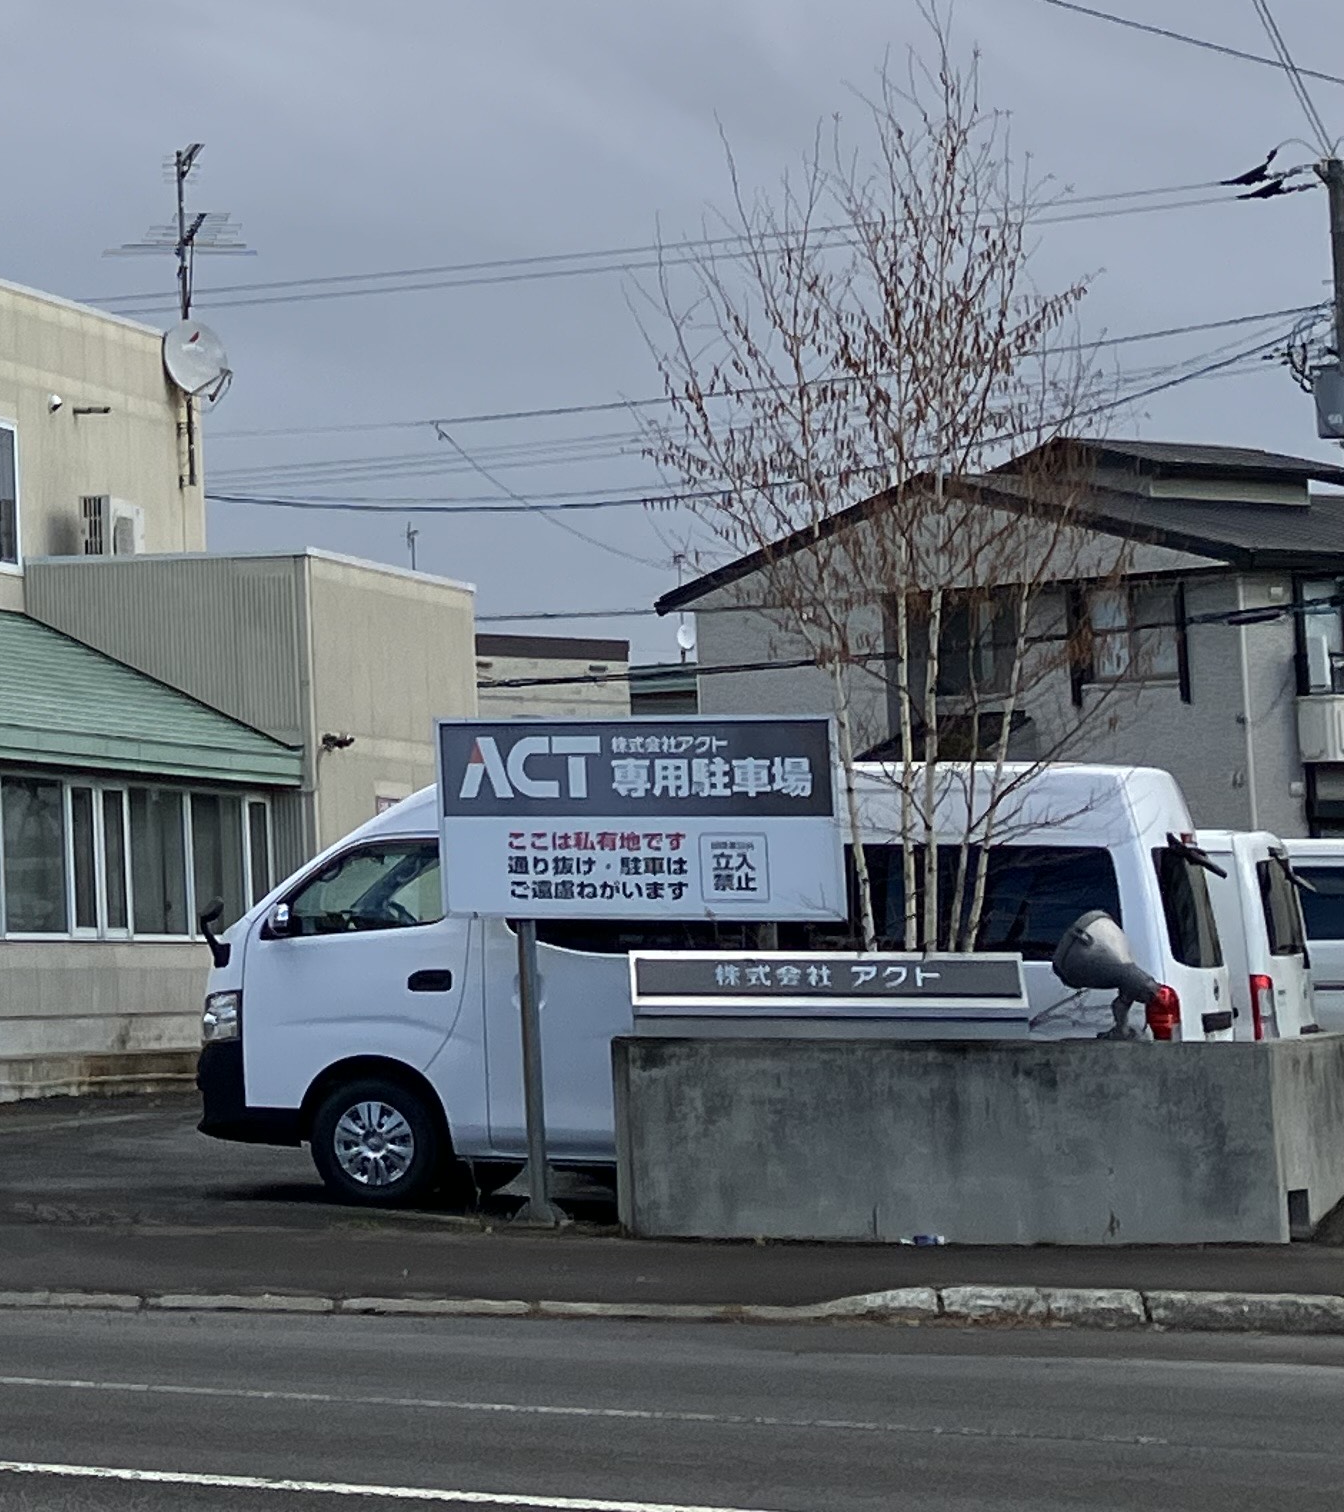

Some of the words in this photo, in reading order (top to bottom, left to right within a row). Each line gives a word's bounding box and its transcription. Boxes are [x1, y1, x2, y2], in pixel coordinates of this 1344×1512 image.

[611, 735, 728, 754] 株式会社アクト
[459, 736, 601, 798] ACT
[611, 757, 812, 798] 専用駐車場
[507, 831, 686, 852] ここは私有地です
[507, 855, 688, 876] 通り抜け・駐車は
[712, 851, 756, 871] 立入
[510, 879, 689, 901] ご遠慮ねがいます
[713, 872, 758, 892] 禁止
[715, 964, 832, 987] 株式会社
[850, 965, 941, 988] アクト
